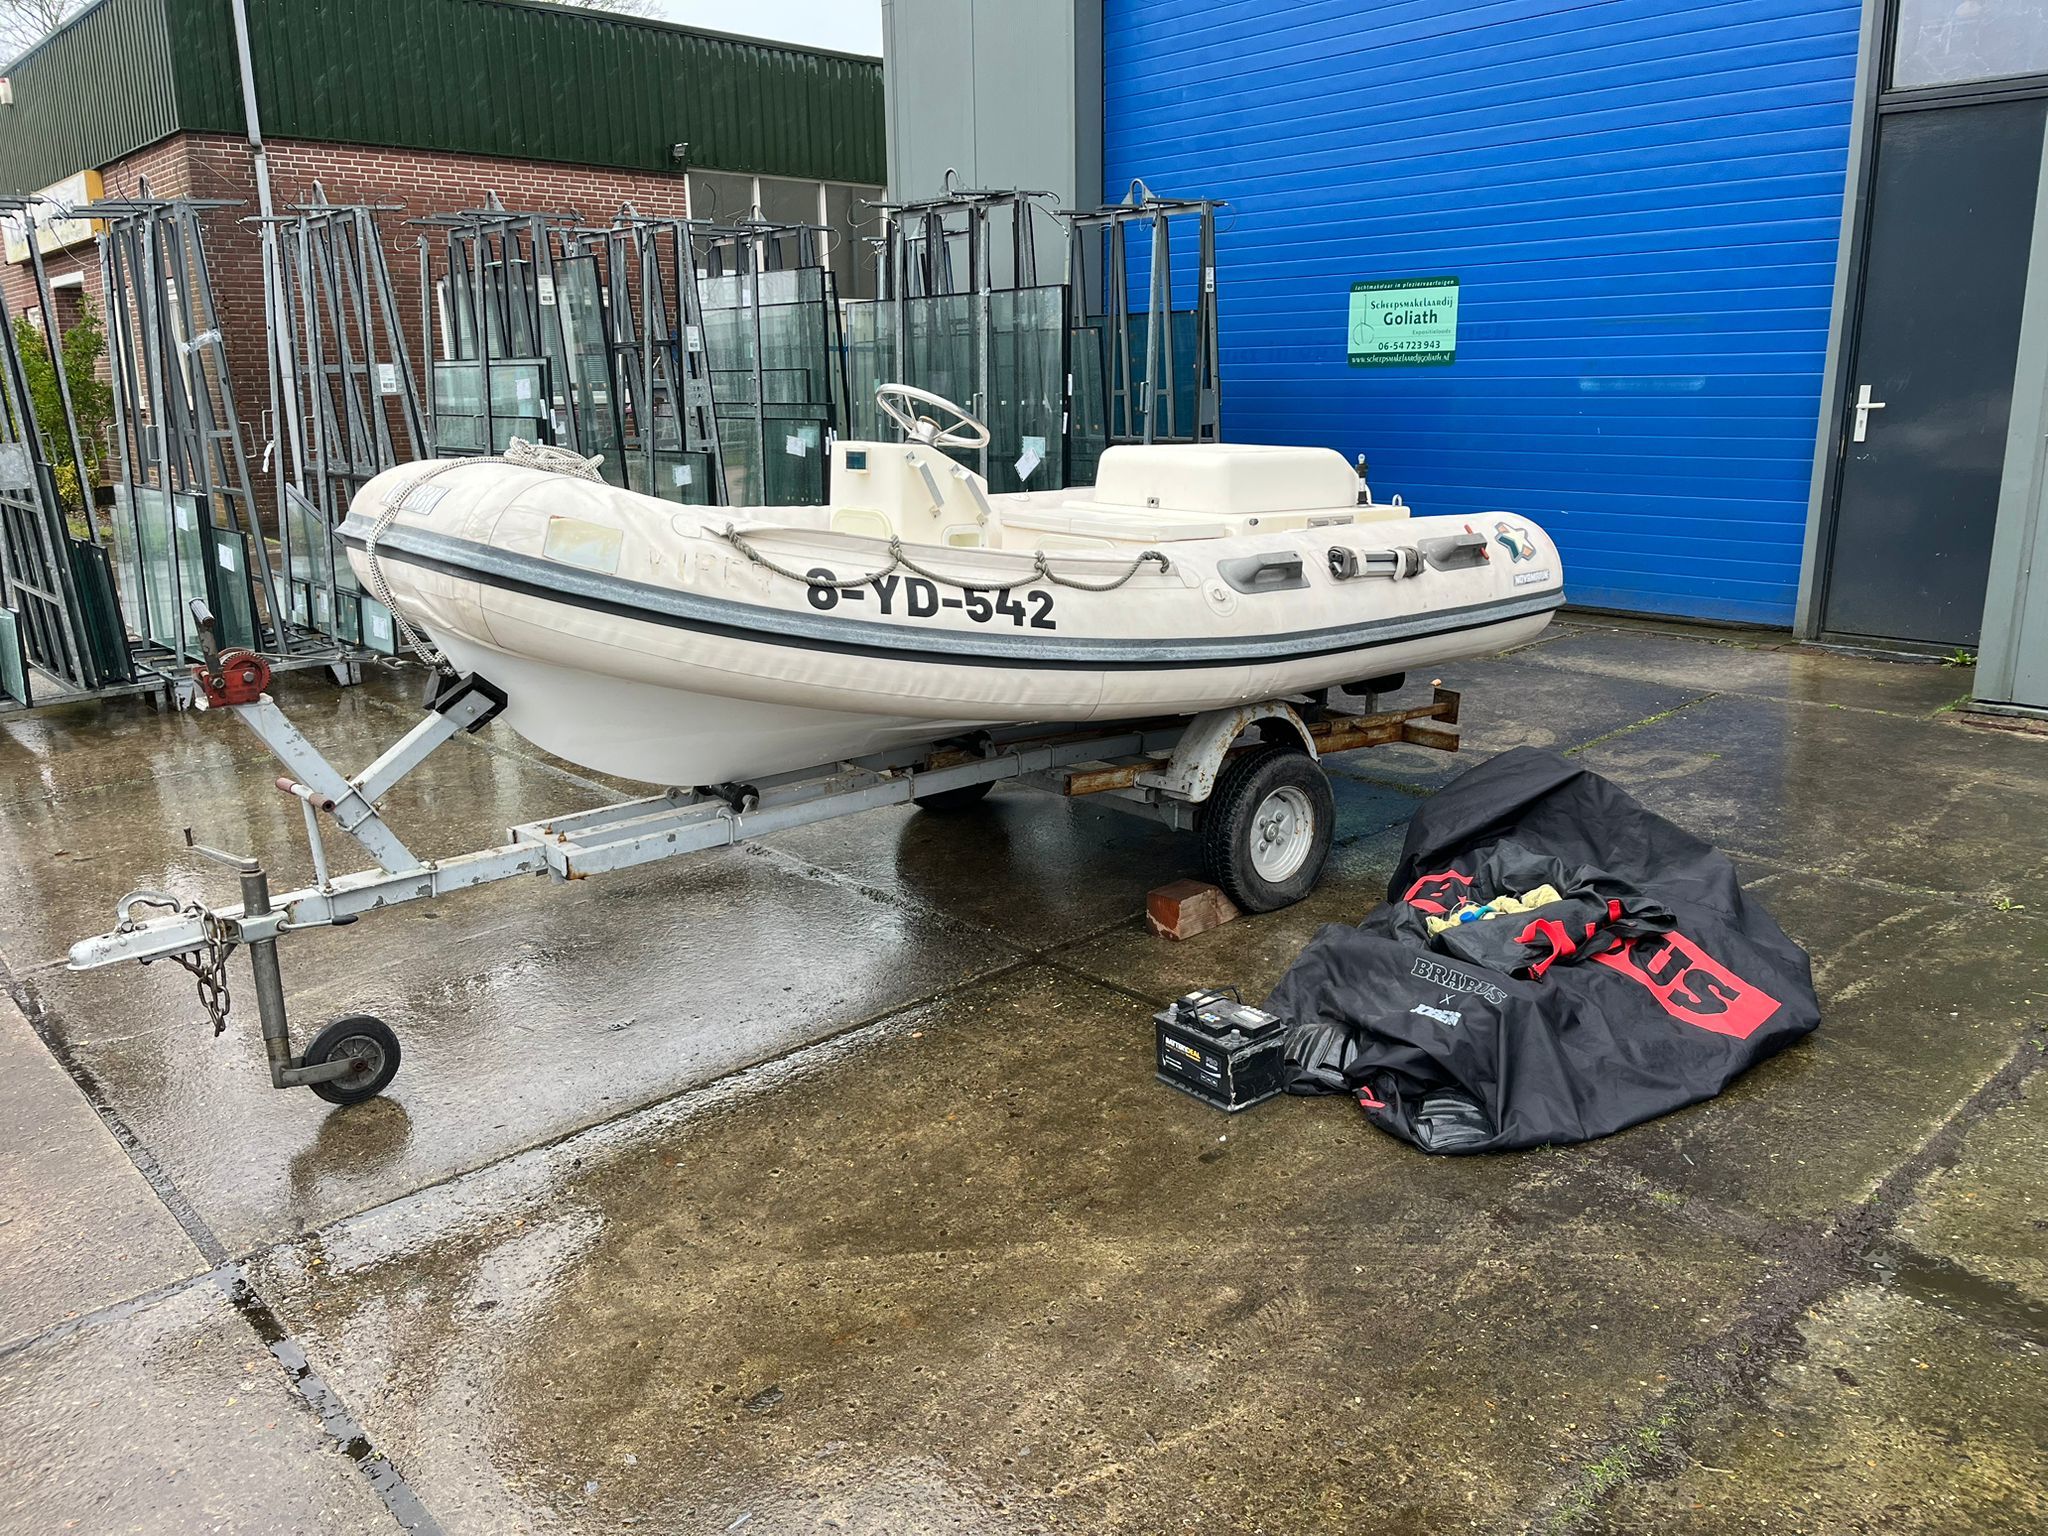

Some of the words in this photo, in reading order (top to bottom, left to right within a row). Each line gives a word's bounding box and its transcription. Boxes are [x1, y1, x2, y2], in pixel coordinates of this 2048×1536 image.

[1370, 296, 1453, 310] Scheepsmakelaardij
[1383, 309, 1438, 325] Goliath
[806, 567, 1057, 630] 8-YD-542
[1410, 957, 1508, 1005] BRABUS
